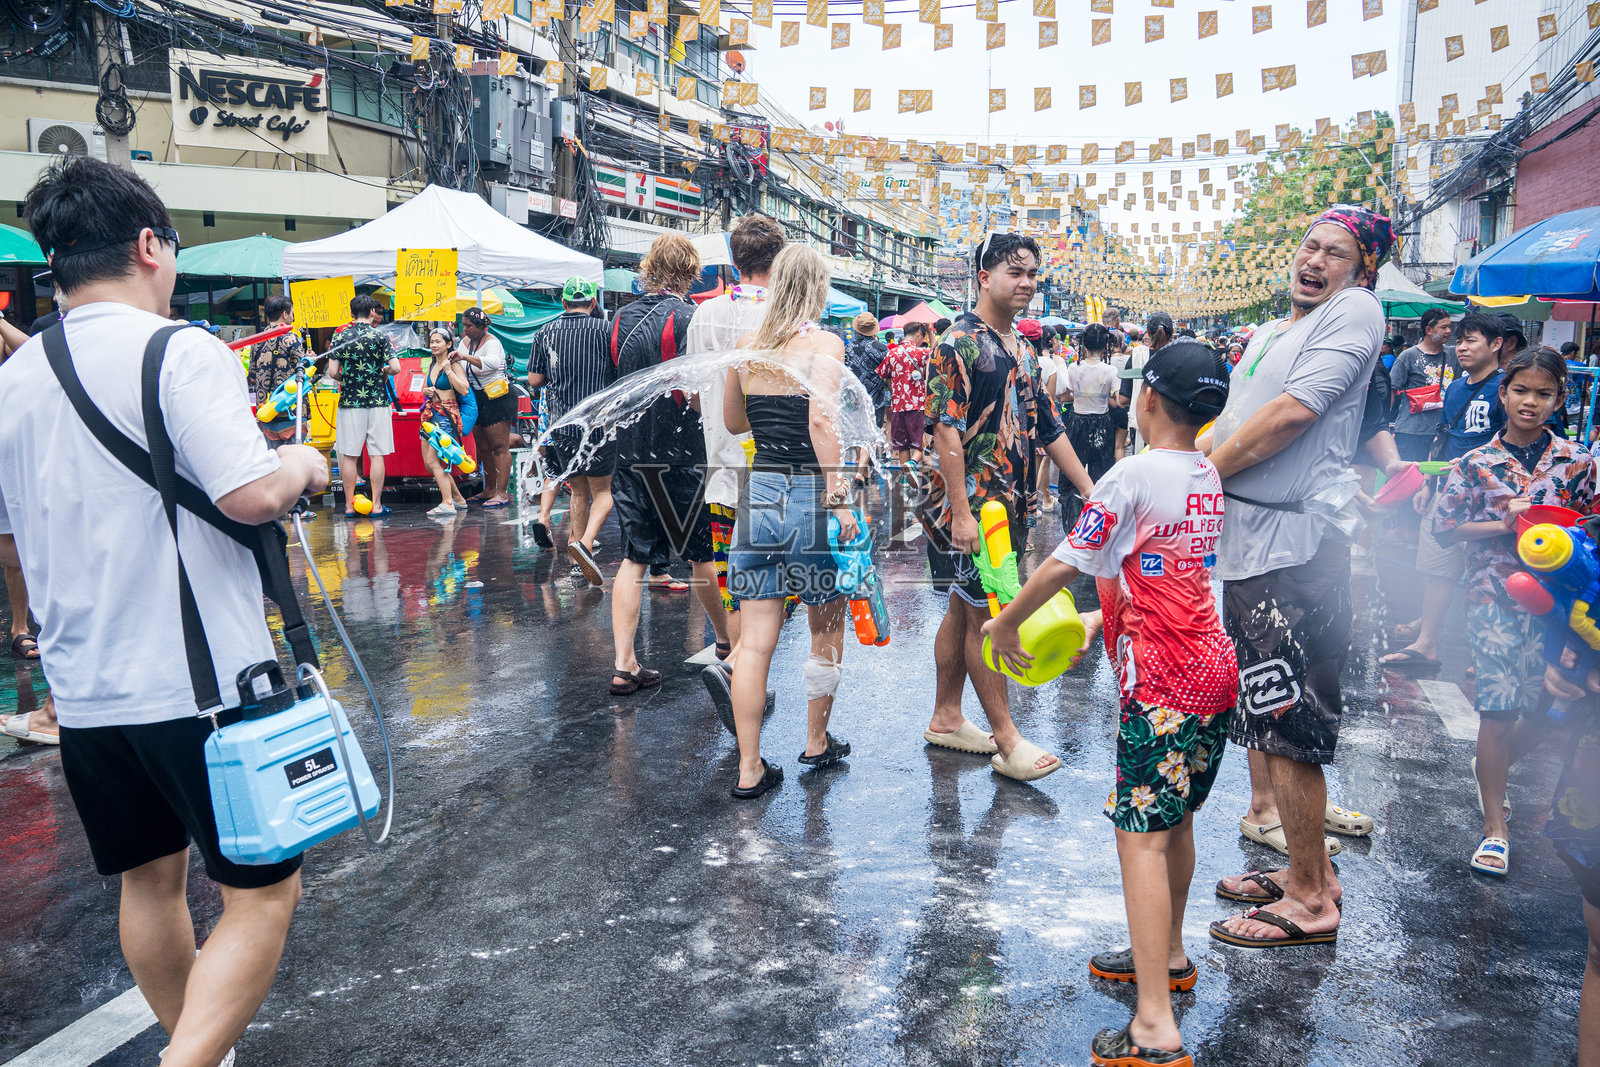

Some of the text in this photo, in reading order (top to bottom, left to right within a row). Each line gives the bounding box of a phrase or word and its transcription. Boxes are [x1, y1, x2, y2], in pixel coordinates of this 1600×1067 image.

[702, 0, 718, 22] SINGHA
[809, 1, 826, 24] SINGHA
[1309, 2, 1324, 24] SINGHA
[782, 24, 798, 44] SINGHA
[1095, 22, 1110, 42] SINGHA
[1202, 14, 1216, 35] SINGHA
[885, 27, 900, 47] SINGHA
[989, 26, 1004, 46] SINGHA
[213, 109, 264, 128] Street
[414, 283, 424, 306] 5
[1145, 370, 1160, 384] Ari
[1142, 558, 1160, 568] TV
[292, 763, 335, 785] POWER SPRAYER
[304, 758, 320, 772] 5L
